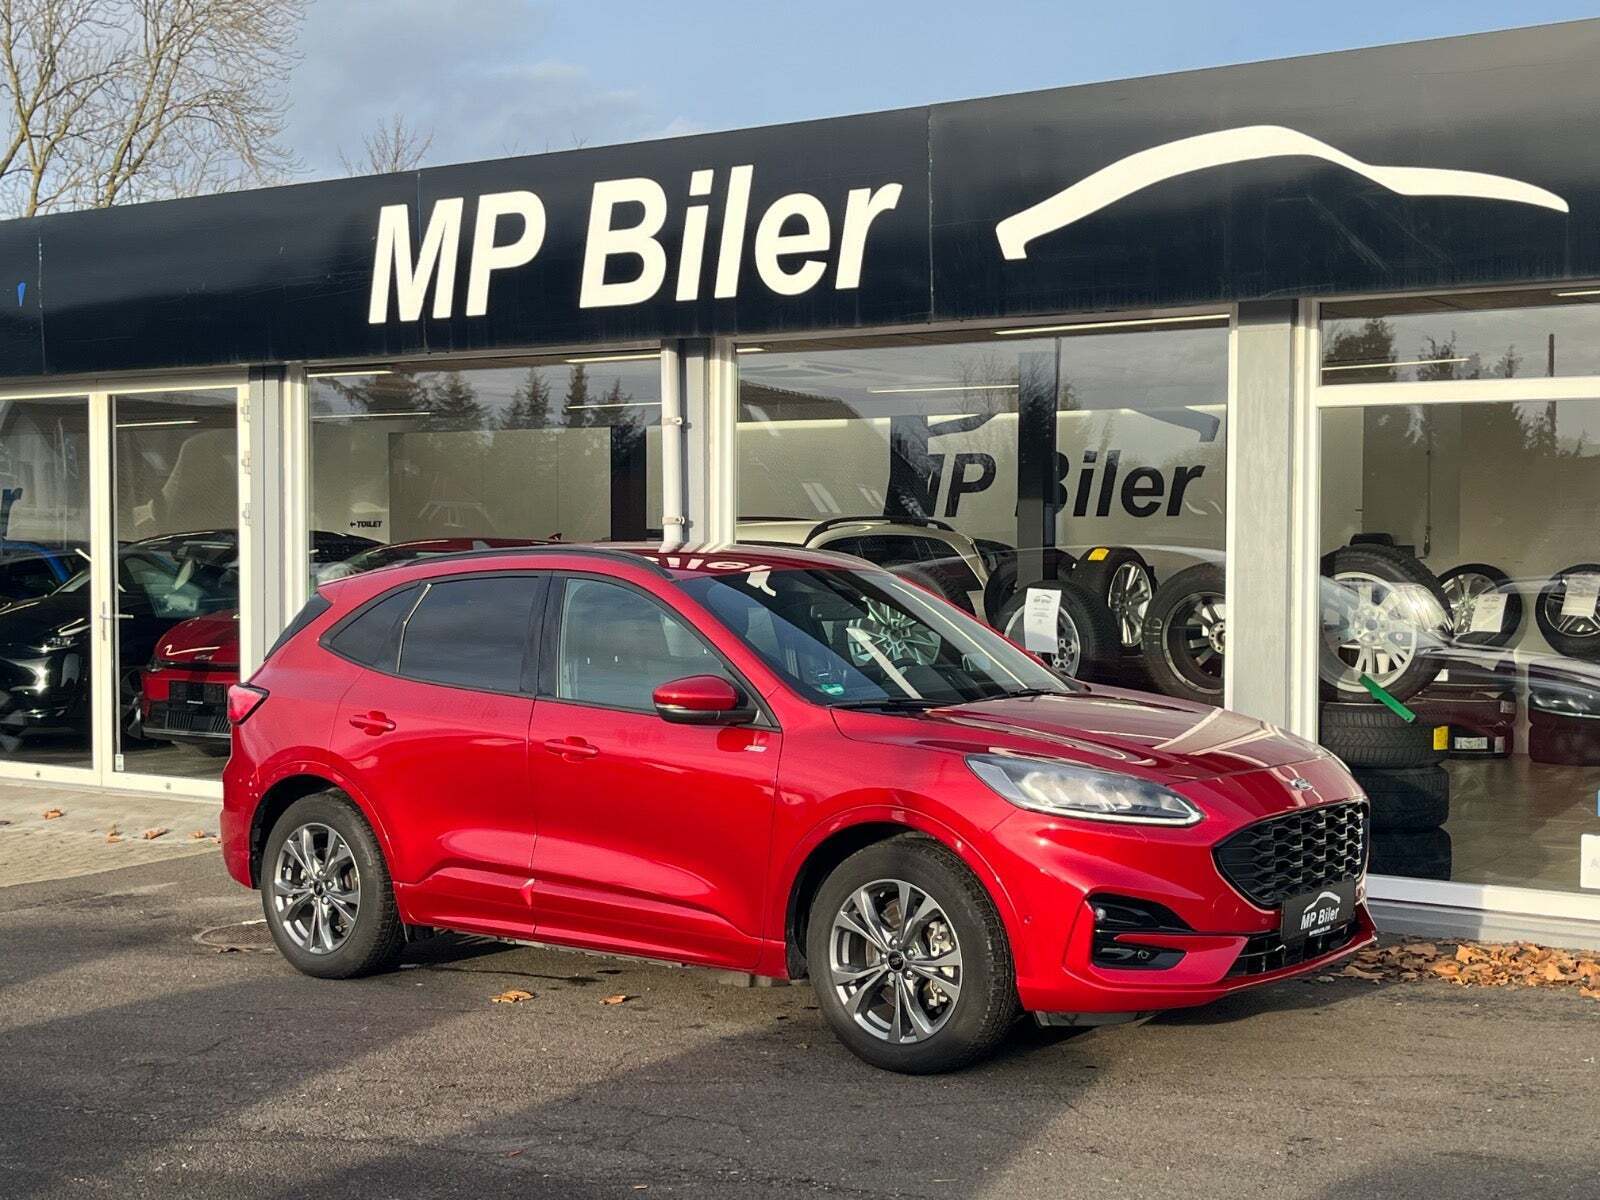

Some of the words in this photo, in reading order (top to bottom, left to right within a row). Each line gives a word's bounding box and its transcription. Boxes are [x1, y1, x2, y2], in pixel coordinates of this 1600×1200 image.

[368, 190, 547, 325] MP
[579, 164, 904, 310] Biler
[356, 519, 383, 529] TOILET
[1300, 911, 1317, 930] MP
[1317, 906, 1340, 925] Biler
